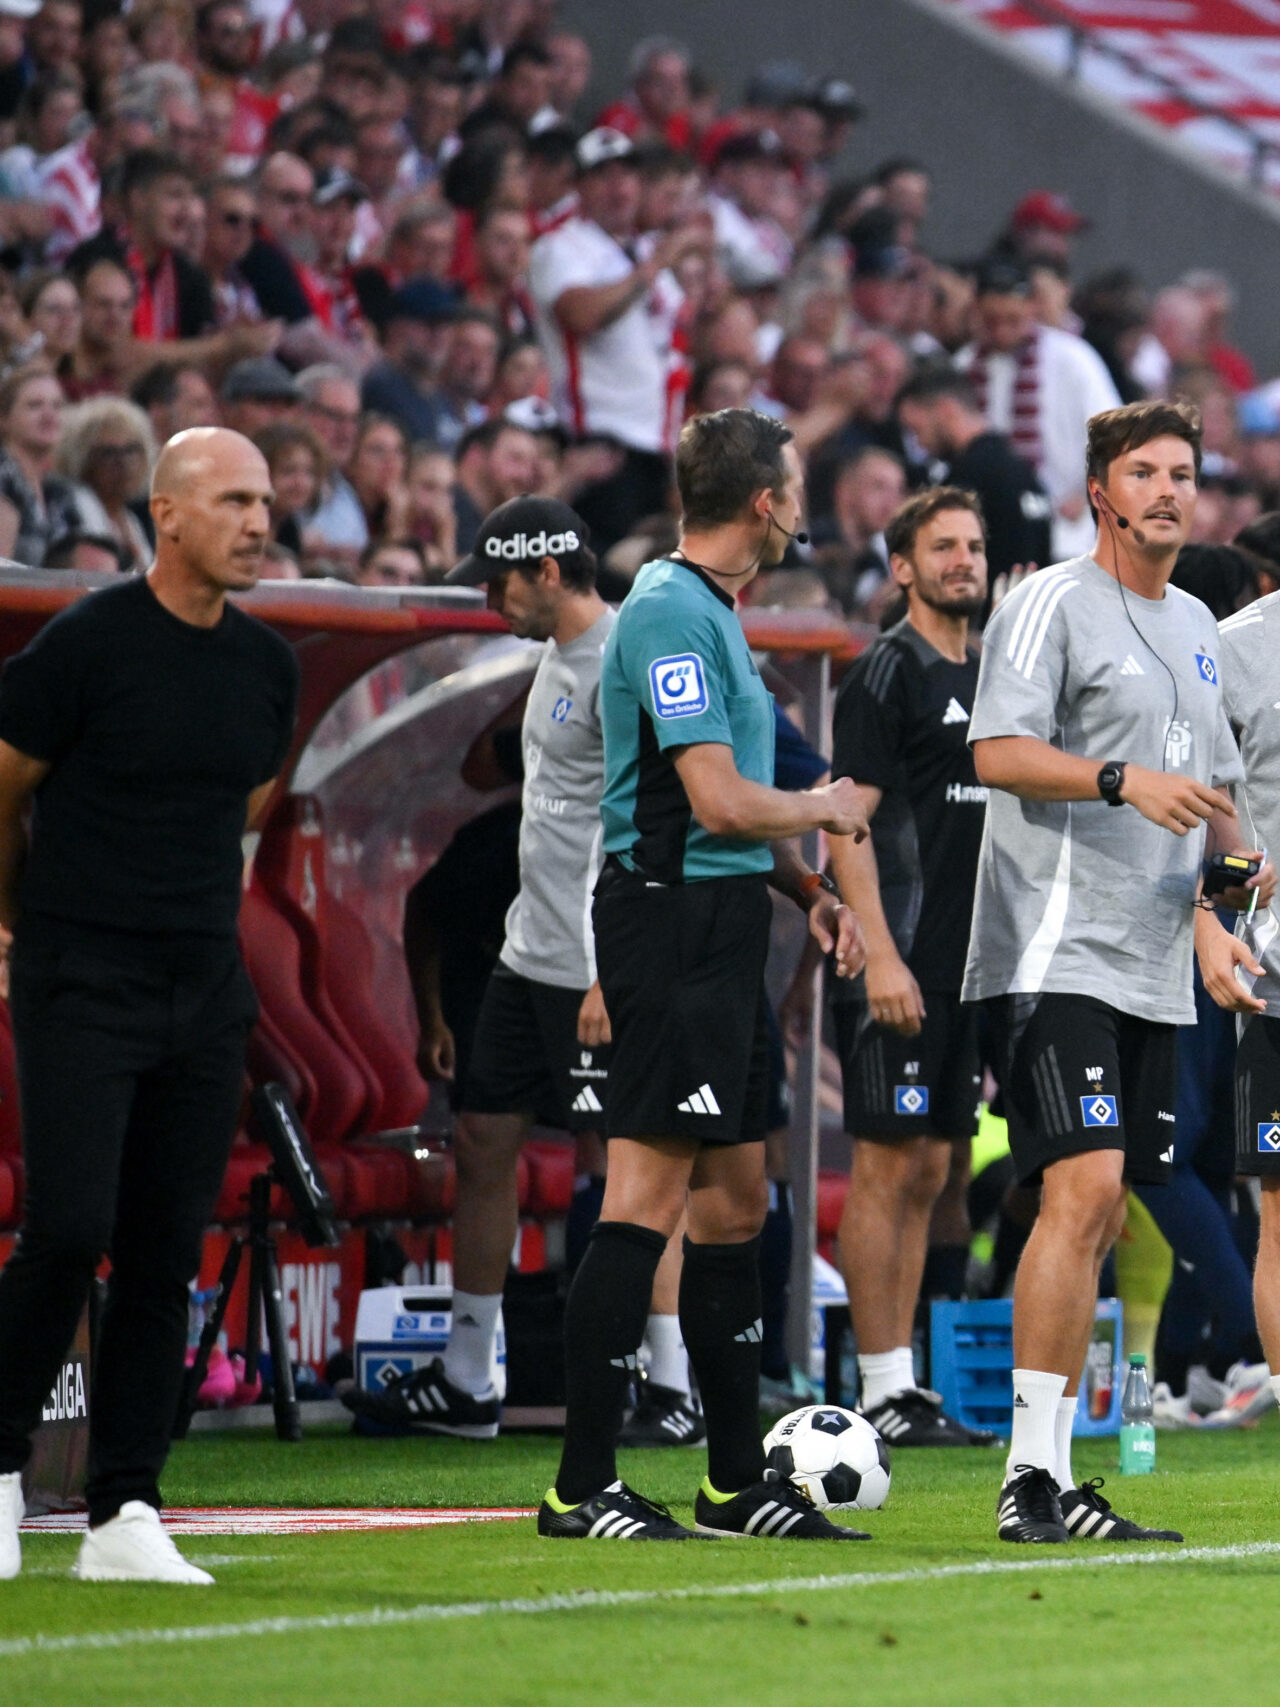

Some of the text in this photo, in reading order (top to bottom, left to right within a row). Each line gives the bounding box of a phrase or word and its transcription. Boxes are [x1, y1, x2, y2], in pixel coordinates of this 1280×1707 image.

[485, 530, 580, 560] adidas
[1085, 1066, 1104, 1081] MP
[261, 1262, 342, 1363] EWE
